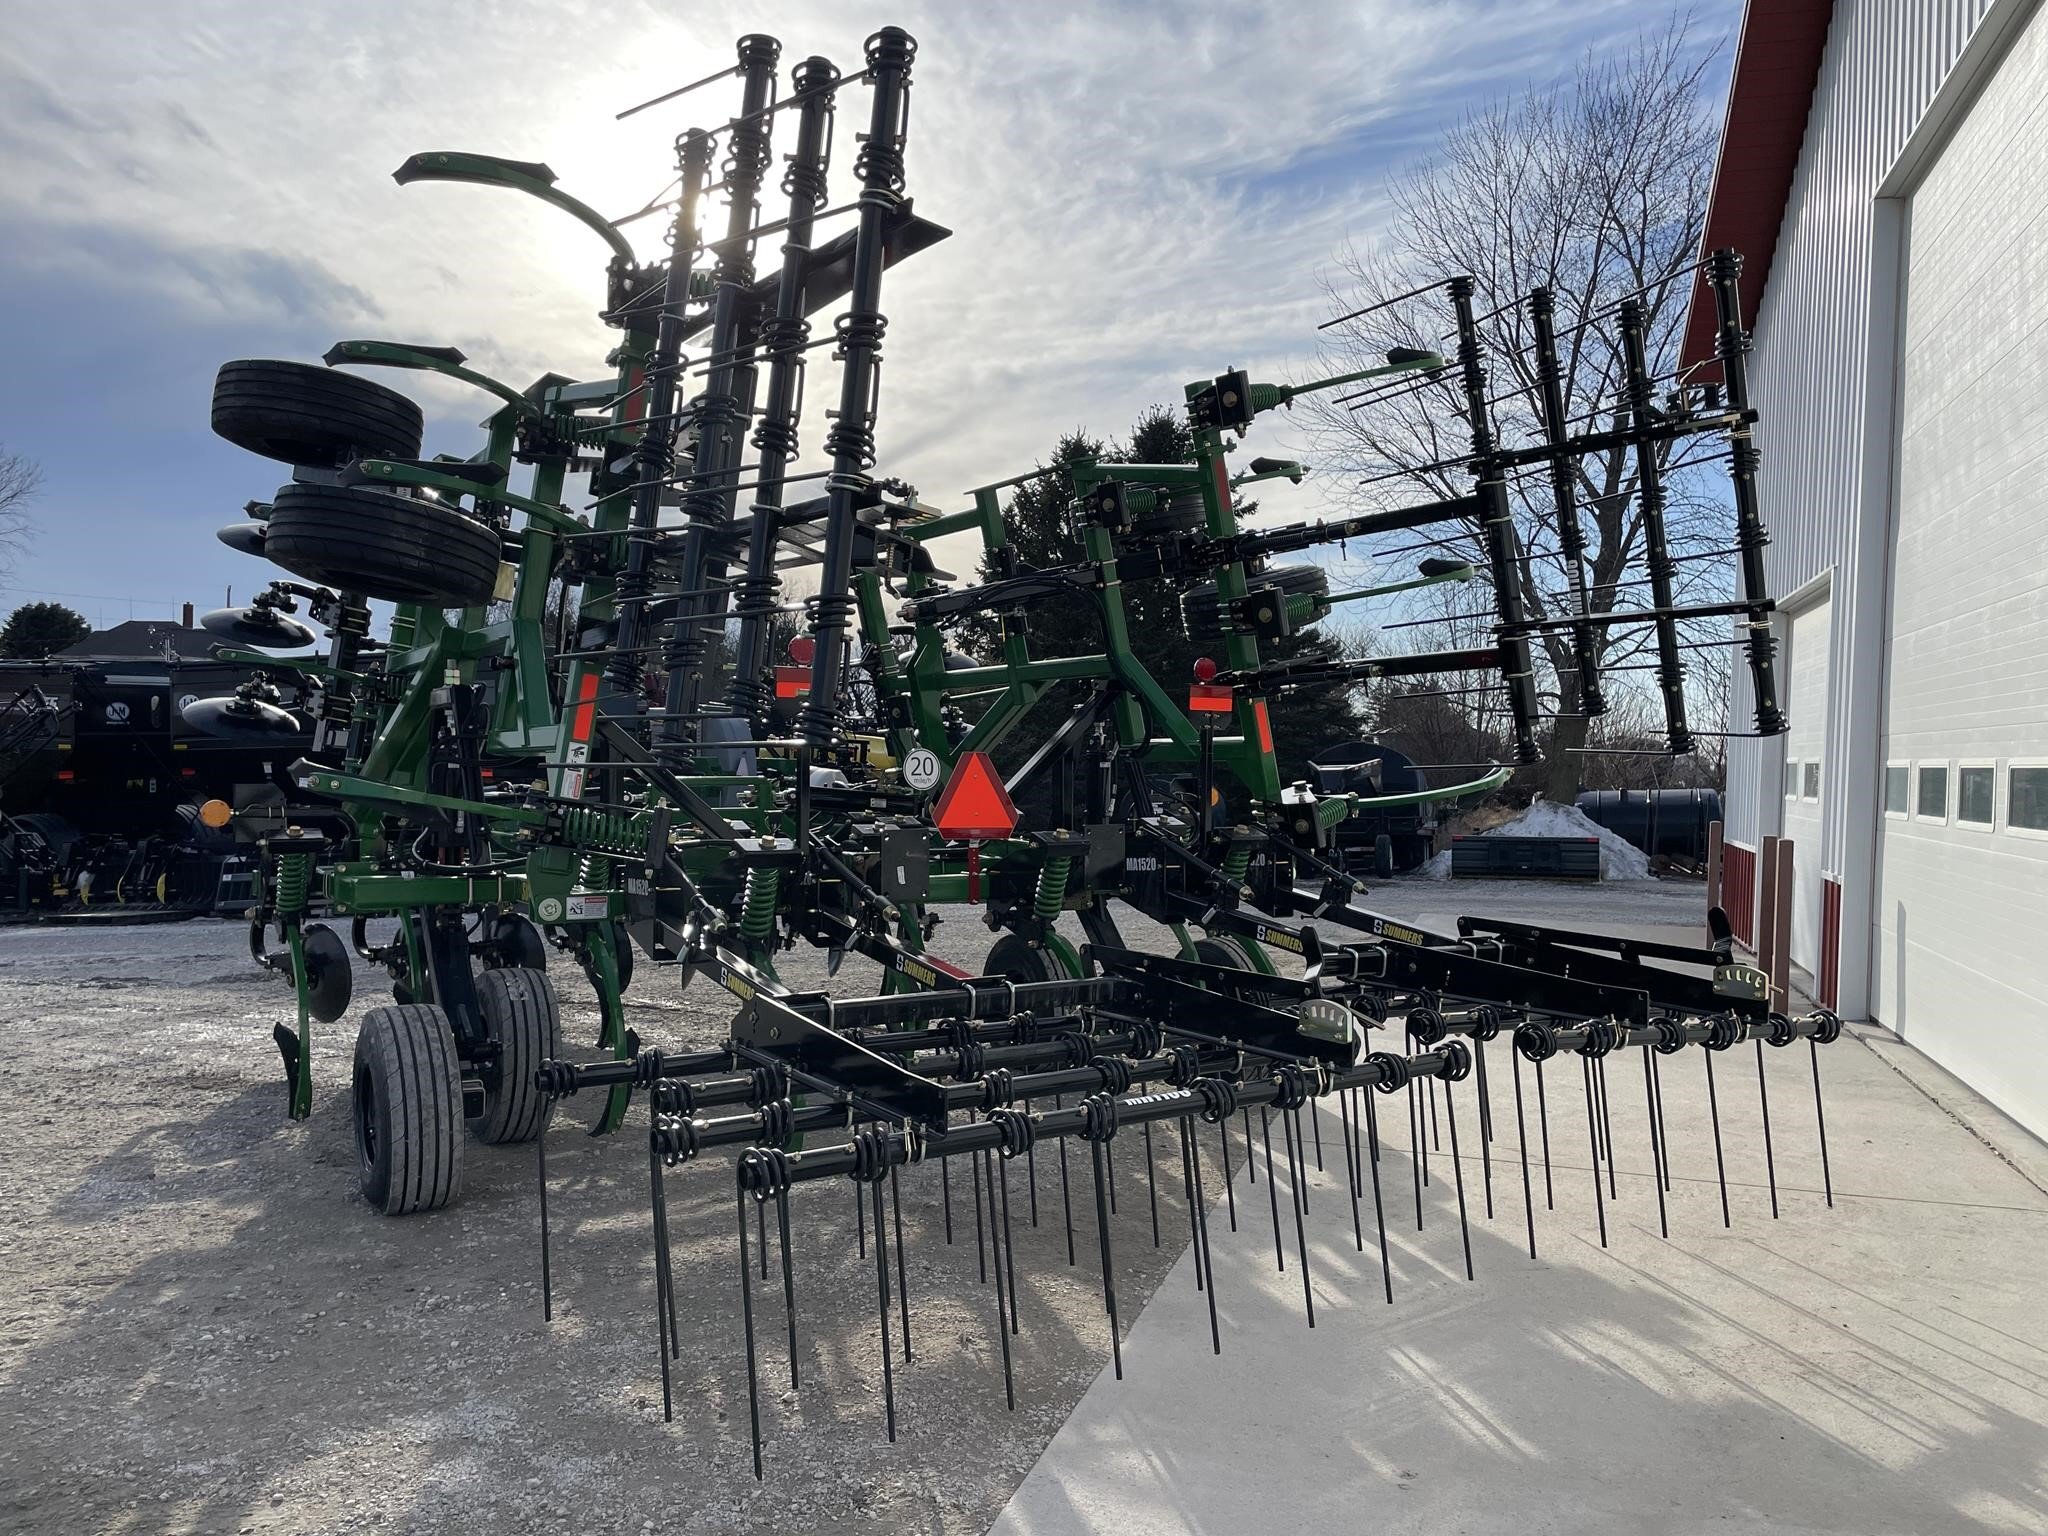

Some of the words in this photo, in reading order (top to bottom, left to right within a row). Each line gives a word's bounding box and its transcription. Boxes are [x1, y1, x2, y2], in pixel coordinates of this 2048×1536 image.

[911, 757, 934, 776] 20
[1126, 857, 1157, 871] MA1520
[627, 877, 649, 896] MA1520
[1383, 923, 1424, 946] SUMMERS
[903, 959, 937, 987] SUMMERS
[727, 973, 755, 1001] SUMMERS
